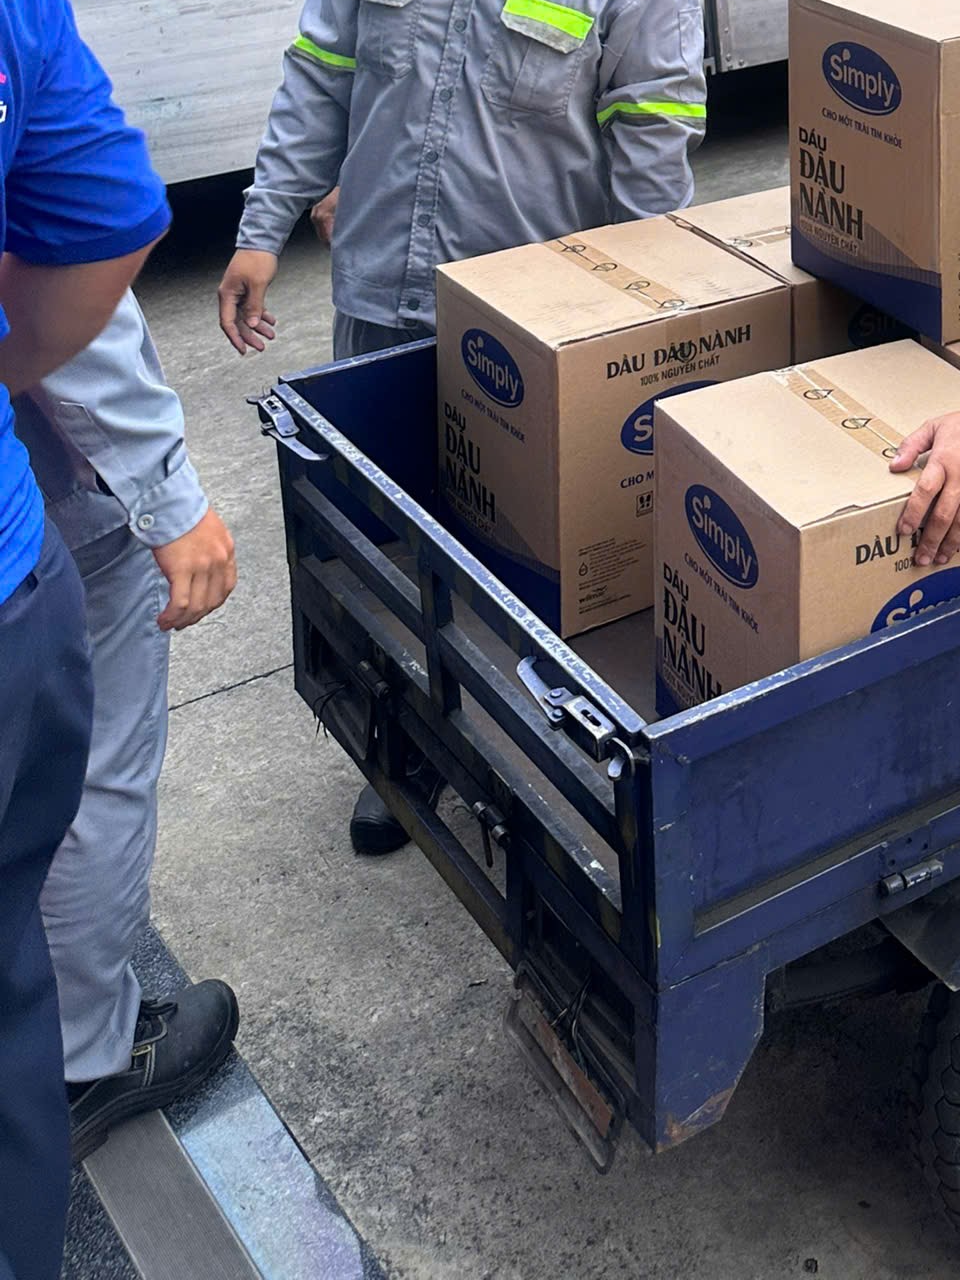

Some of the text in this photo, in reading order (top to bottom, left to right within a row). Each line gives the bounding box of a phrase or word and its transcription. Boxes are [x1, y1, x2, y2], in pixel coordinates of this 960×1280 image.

[830, 47, 894, 108] Simply
[822, 107, 838, 121] CHO
[870, 127, 882, 140] TIM
[799, 182, 863, 240] NÀNH
[467, 335, 519, 401] Simply
[698, 324, 751, 354] NÀNH
[640, 373, 660, 387] 100%
[445, 456, 496, 523] NÀNH
[620, 471, 644, 489] CHO
[691, 494, 753, 580] Simply
